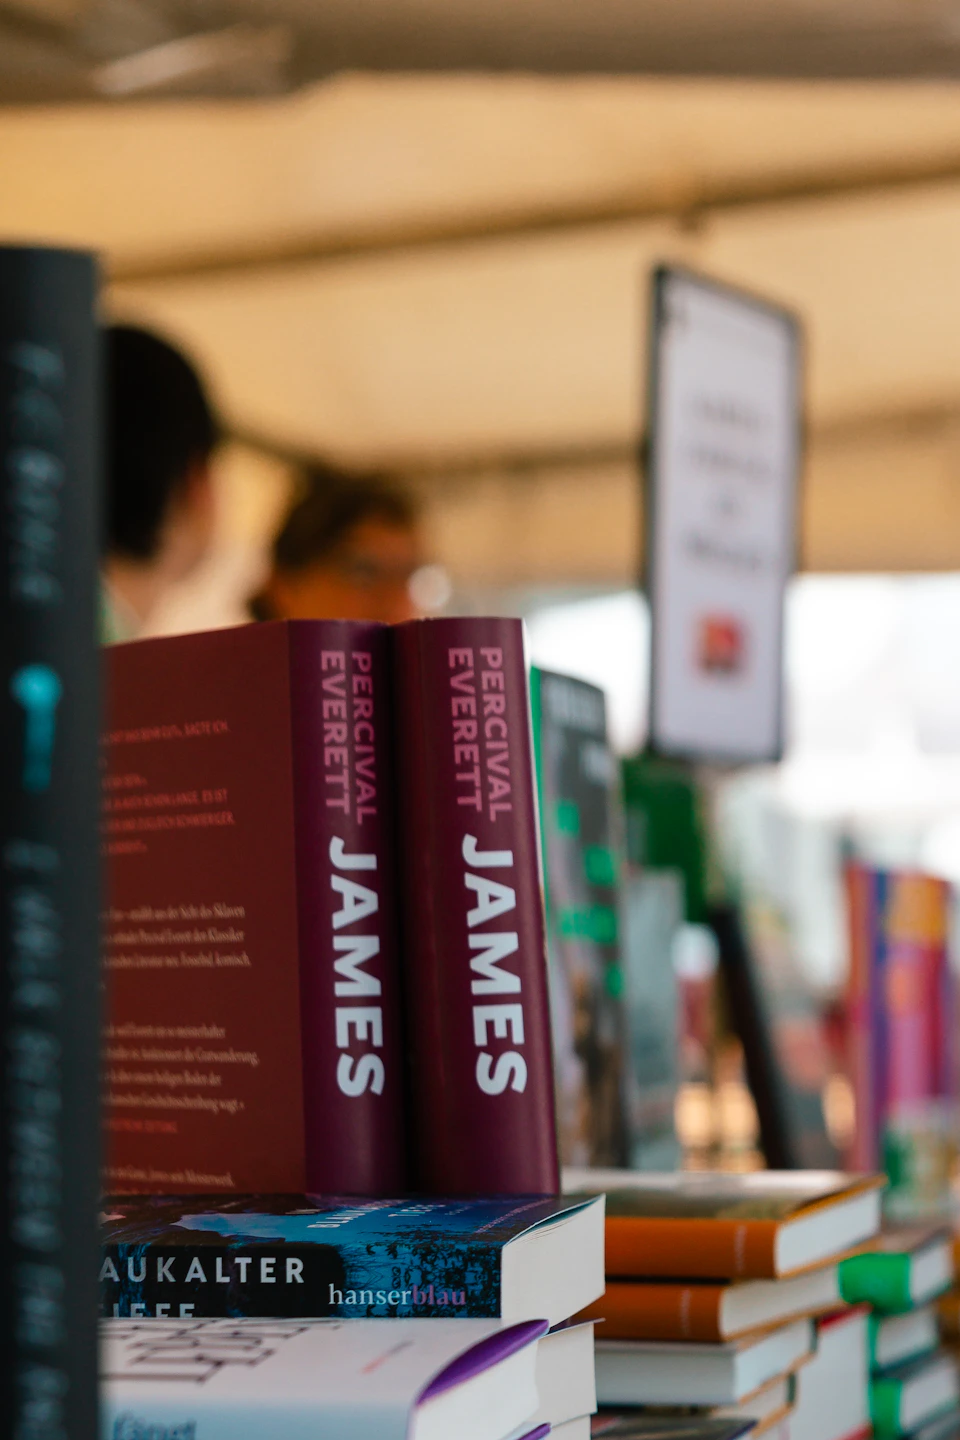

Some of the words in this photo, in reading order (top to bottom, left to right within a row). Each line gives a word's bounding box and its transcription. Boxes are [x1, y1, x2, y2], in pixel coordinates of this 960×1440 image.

[320, 649, 351, 815] EVERETT
[352, 651, 378, 825] PERCIVAL
[448, 647, 483, 812] EVERETT
[480, 646, 513, 821] PERCIVAL
[328, 836, 385, 1097] JAMES
[462, 833, 528, 1096] JAMES
[99, 1303, 195, 1318] IEFE
[328, 1284, 467, 1306] hanserblau
